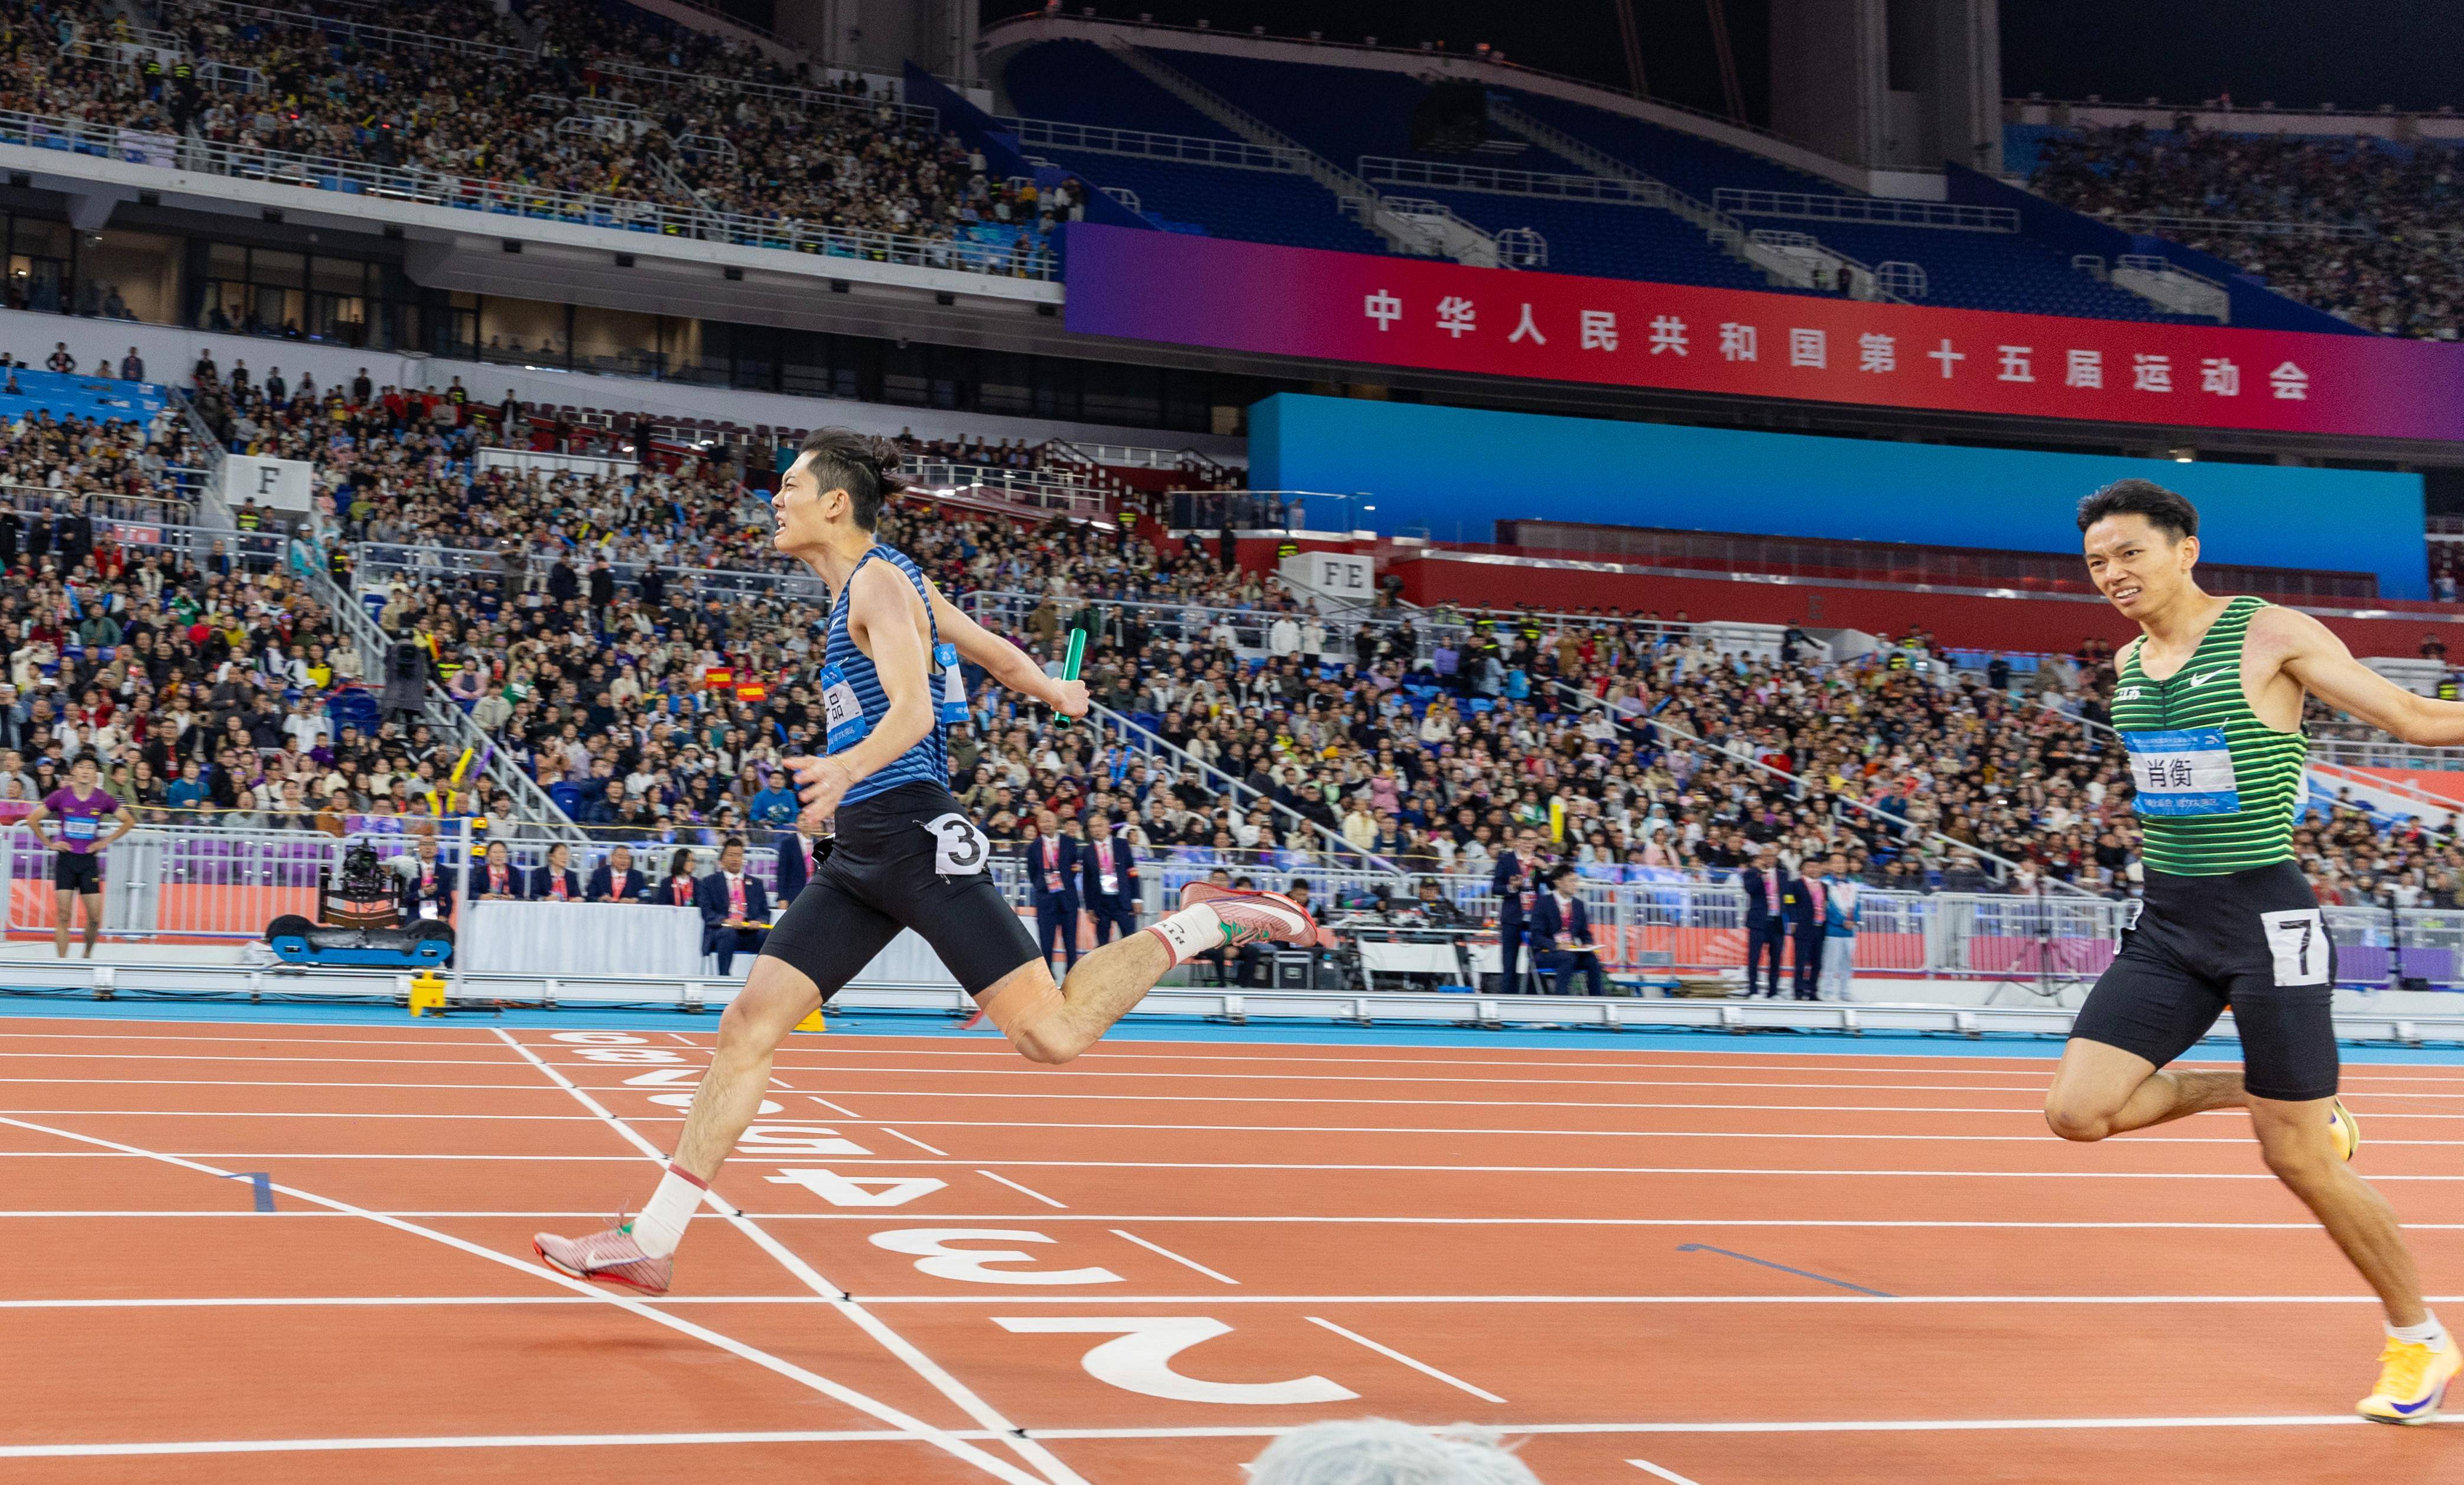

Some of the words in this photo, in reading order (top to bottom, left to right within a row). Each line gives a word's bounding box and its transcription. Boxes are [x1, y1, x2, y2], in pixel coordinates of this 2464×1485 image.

[1364, 288, 2309, 401] 中华人民共和国第十五届运动会
[257, 465, 281, 494] F
[1323, 562, 1363, 588] FE
[2147, 757, 2193, 787] 肖衡
[942, 820, 981, 867] 3
[2278, 919, 2312, 975] 7
[571, 1048, 687, 1063] 8
[734, 1126, 876, 1155] 5
[762, 1168, 950, 1207] 4
[868, 1228, 1127, 1285] 3
[989, 1317, 1362, 1405] 2
